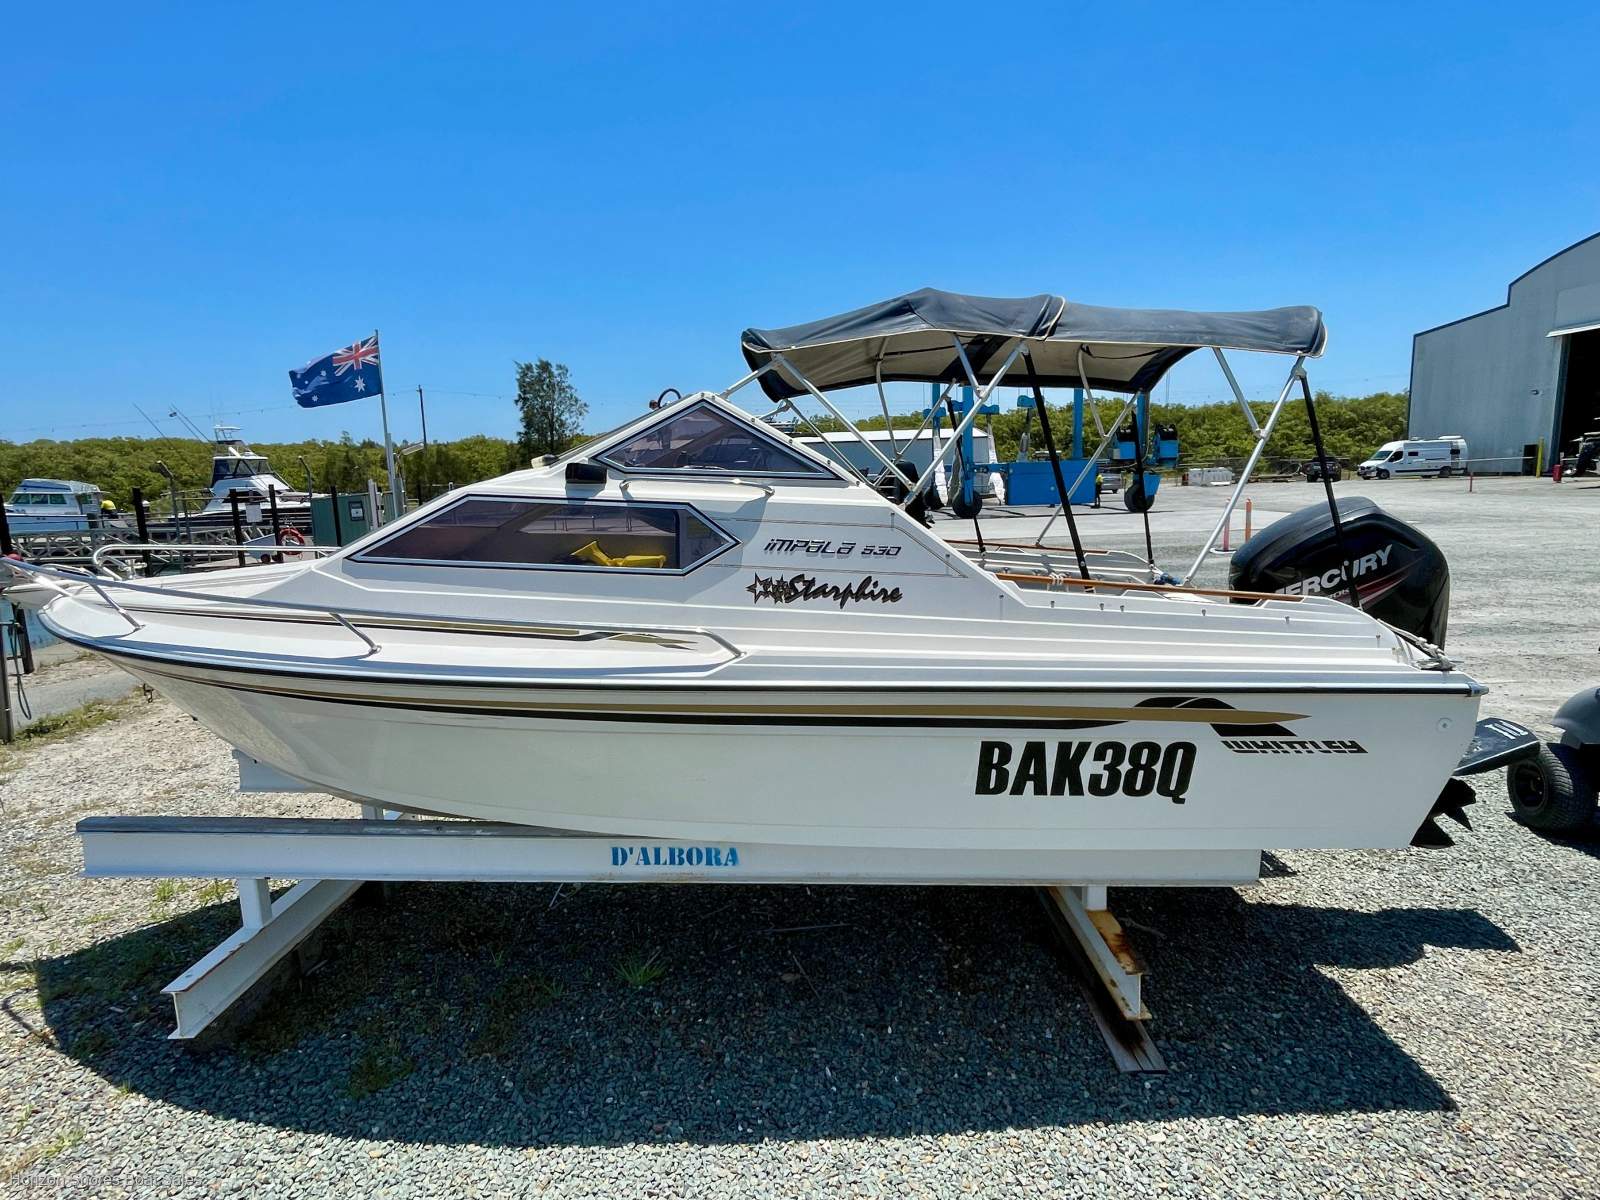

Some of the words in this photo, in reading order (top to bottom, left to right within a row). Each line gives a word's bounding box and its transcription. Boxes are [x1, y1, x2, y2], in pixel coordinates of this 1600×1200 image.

[861, 545, 902, 556] 530
[1275, 544, 1393, 596] ERCURY
[1221, 740, 1369, 754] WHITTLEY
[975, 740, 1198, 804] BAK38Q
[611, 846, 740, 866] D'ALBORA
